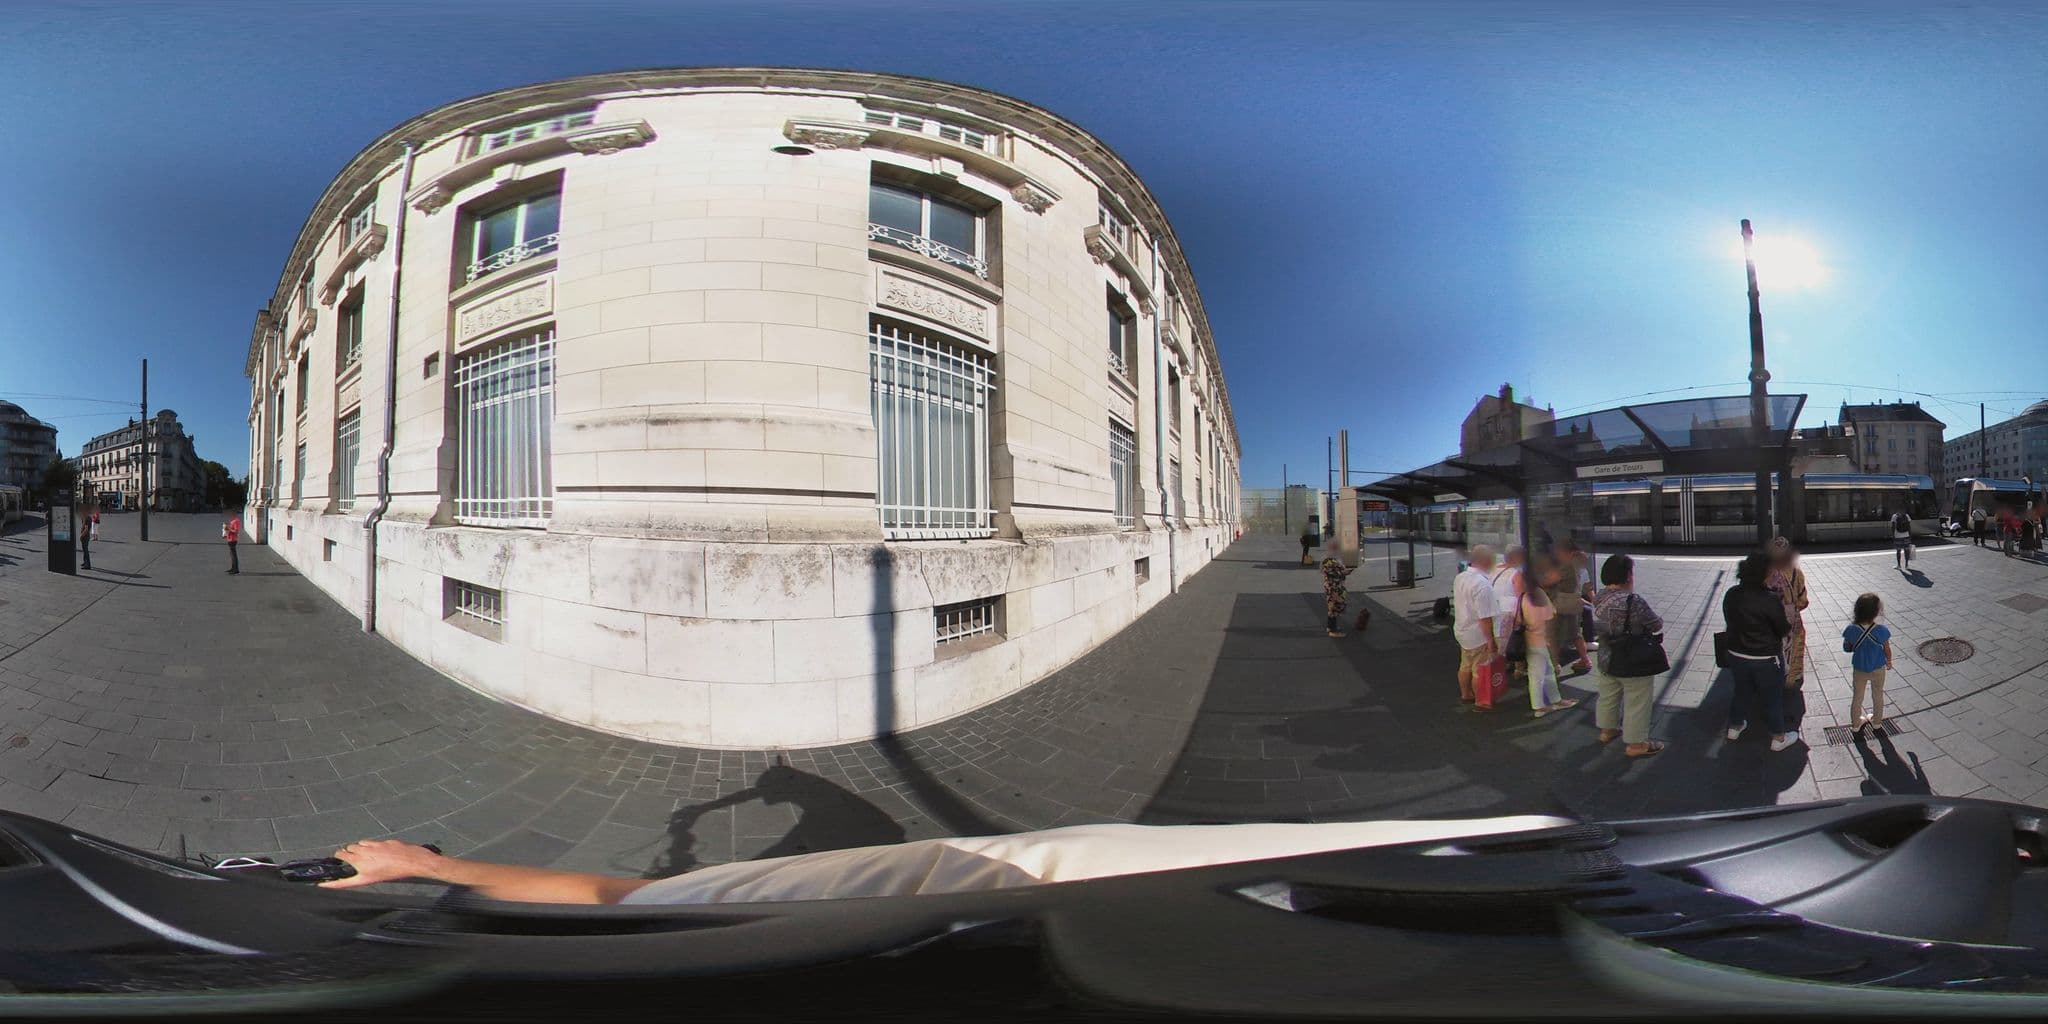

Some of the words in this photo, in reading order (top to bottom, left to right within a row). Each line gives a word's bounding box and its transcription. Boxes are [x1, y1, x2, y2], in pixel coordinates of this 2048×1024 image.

[1594, 466, 1610, 474] Gare
[1612, 465, 1621, 473] de
[1623, 464, 1644, 472] Tours
